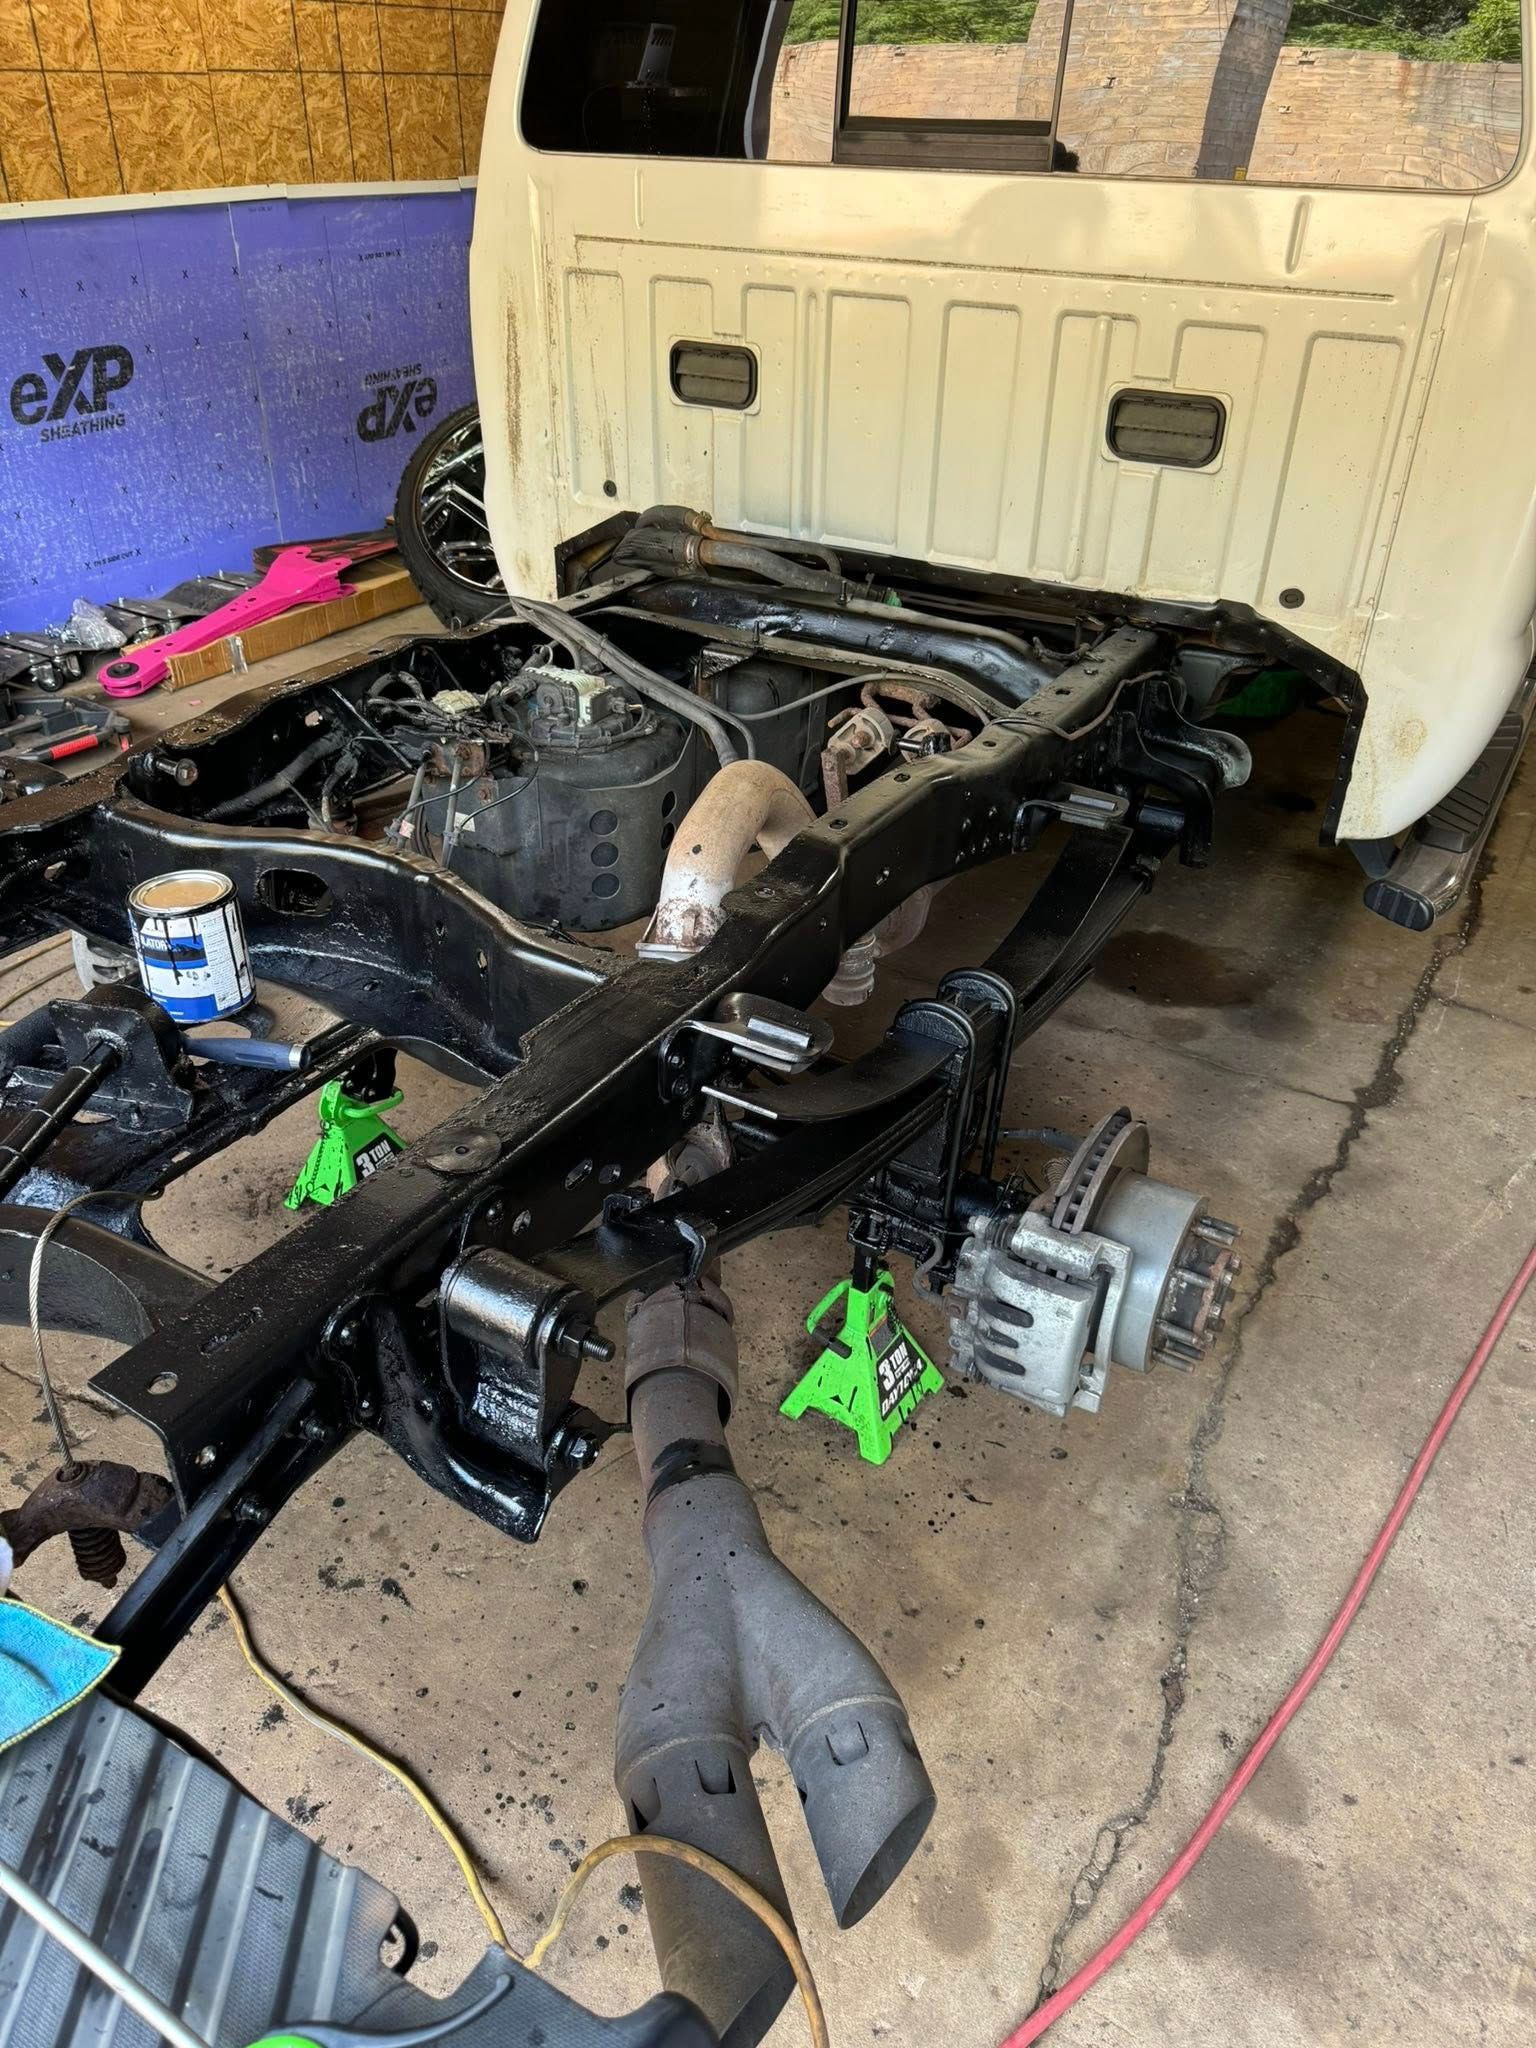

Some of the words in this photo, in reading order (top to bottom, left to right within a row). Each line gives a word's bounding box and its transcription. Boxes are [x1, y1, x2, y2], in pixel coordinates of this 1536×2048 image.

[40, 413, 126, 443] SHEATHING
[356, 1152, 376, 1178] 3
[368, 1139, 391, 1162] TON
[878, 1358, 895, 1391] 3
[890, 1341, 908, 1368] TON
